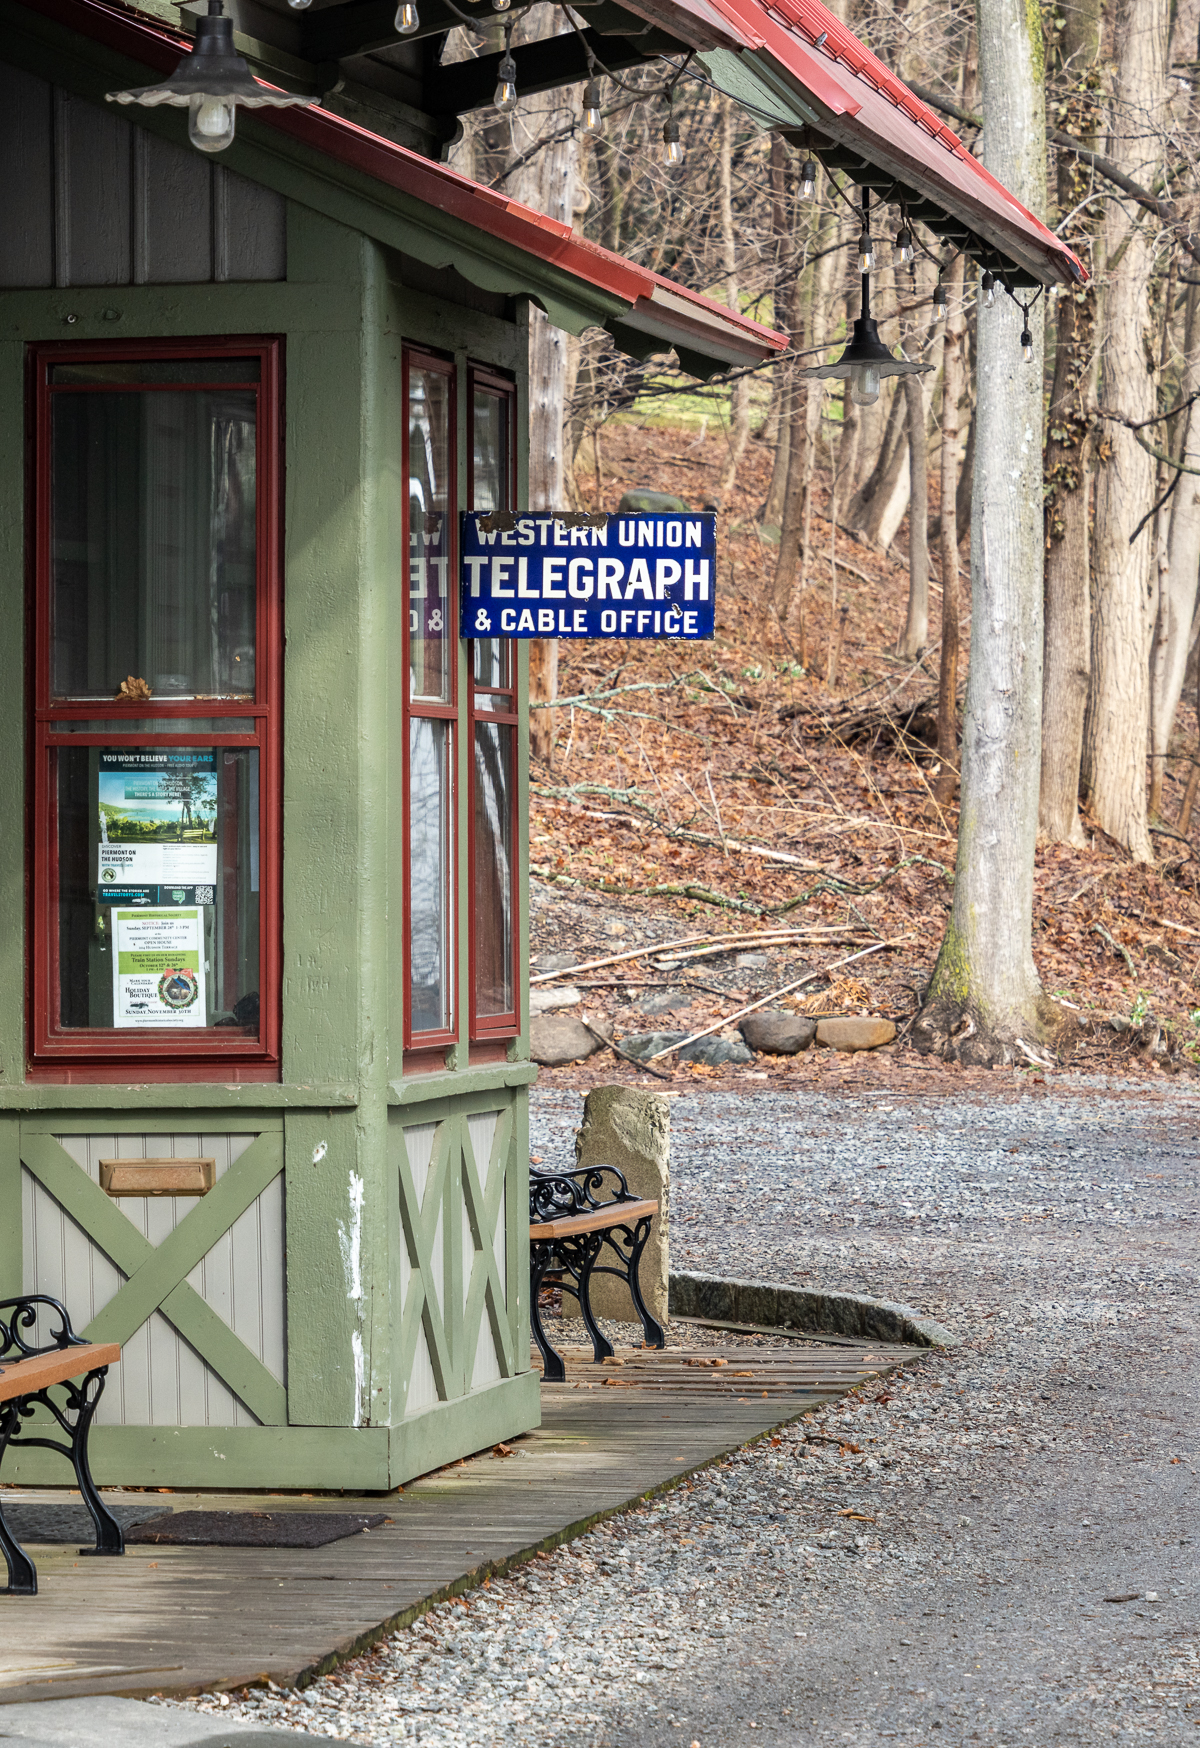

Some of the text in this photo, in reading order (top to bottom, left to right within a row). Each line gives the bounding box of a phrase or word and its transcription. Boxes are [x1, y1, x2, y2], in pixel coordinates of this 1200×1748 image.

[476, 519, 702, 547] WESTERN UNION
[464, 556, 710, 601] TELEGRAPH
[475, 608, 698, 633] & CABLE OFFICE
